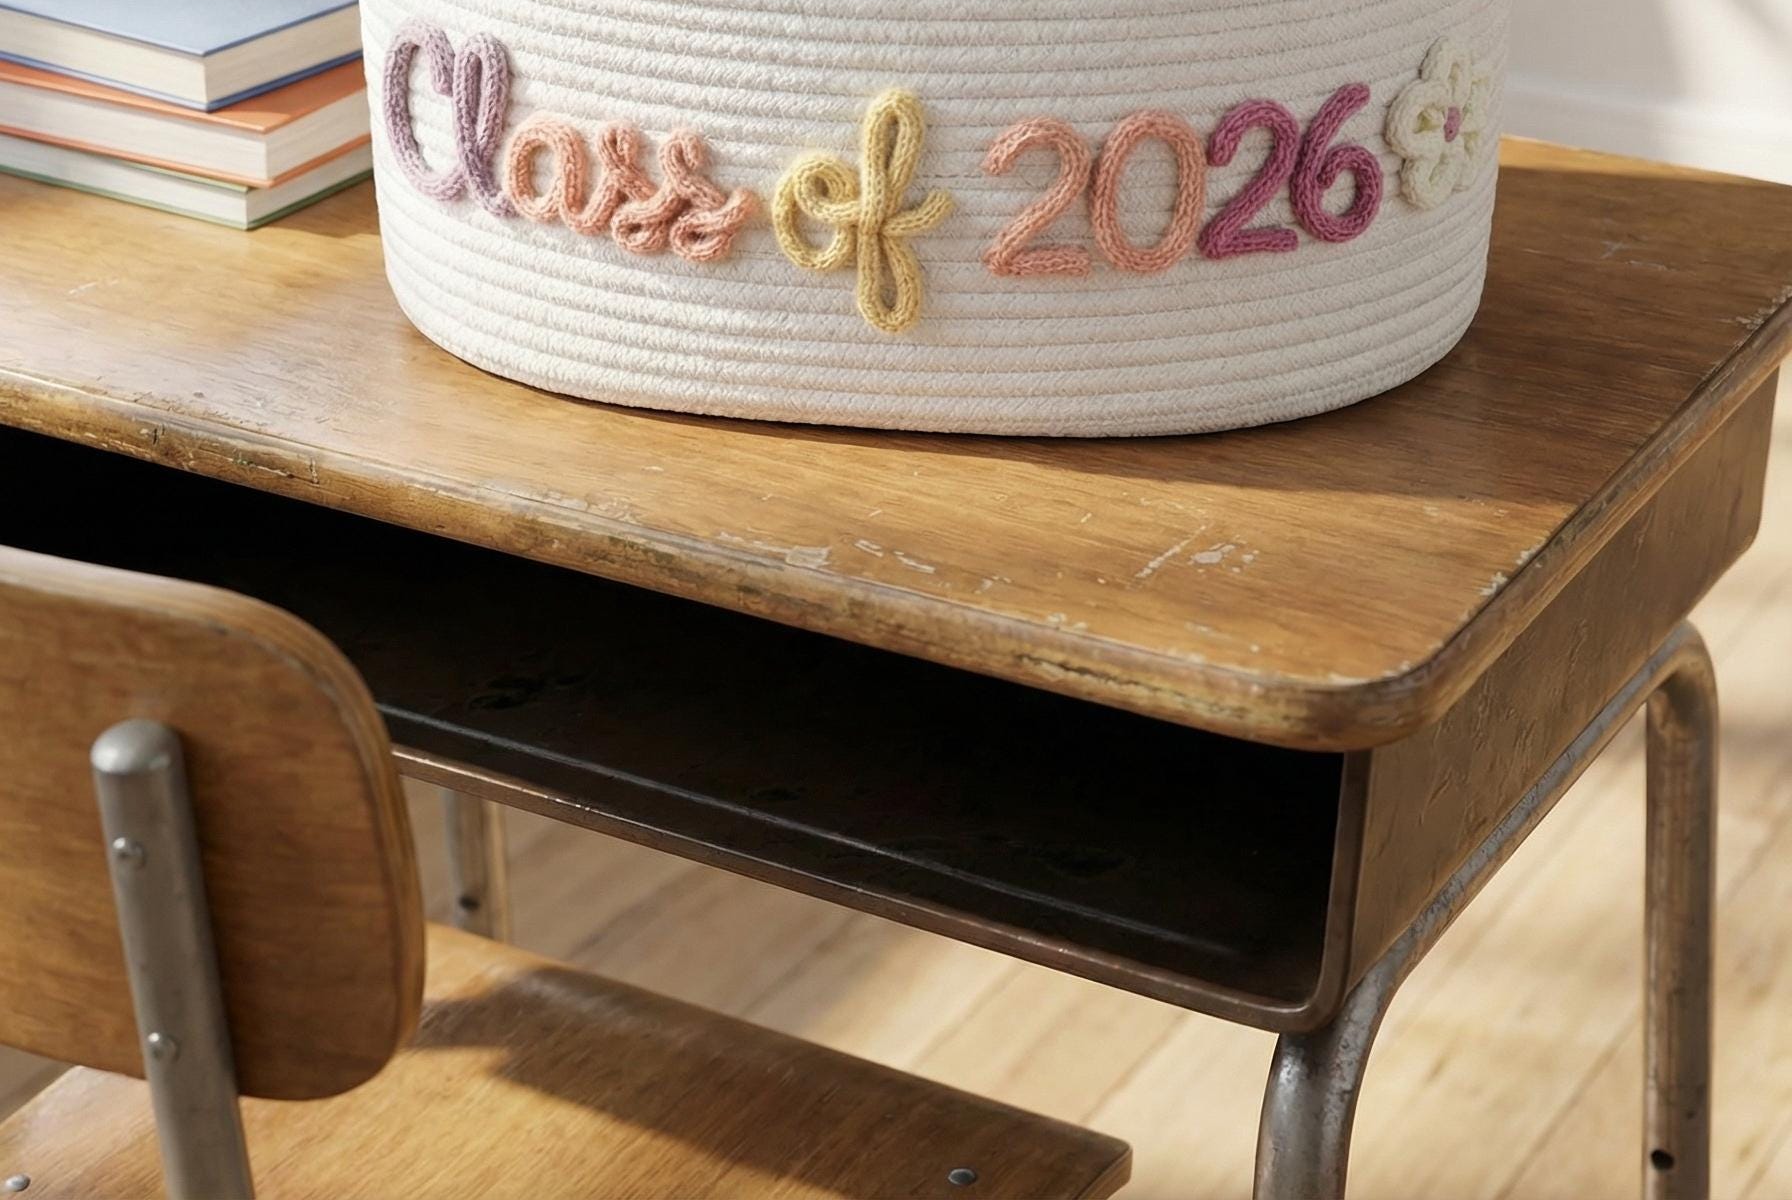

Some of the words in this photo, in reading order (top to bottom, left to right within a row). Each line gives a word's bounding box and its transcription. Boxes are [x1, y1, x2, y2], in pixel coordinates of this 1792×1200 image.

[382, 17, 759, 263] Class
[770, 87, 954, 334] of
[980, 82, 1384, 277] 2026
